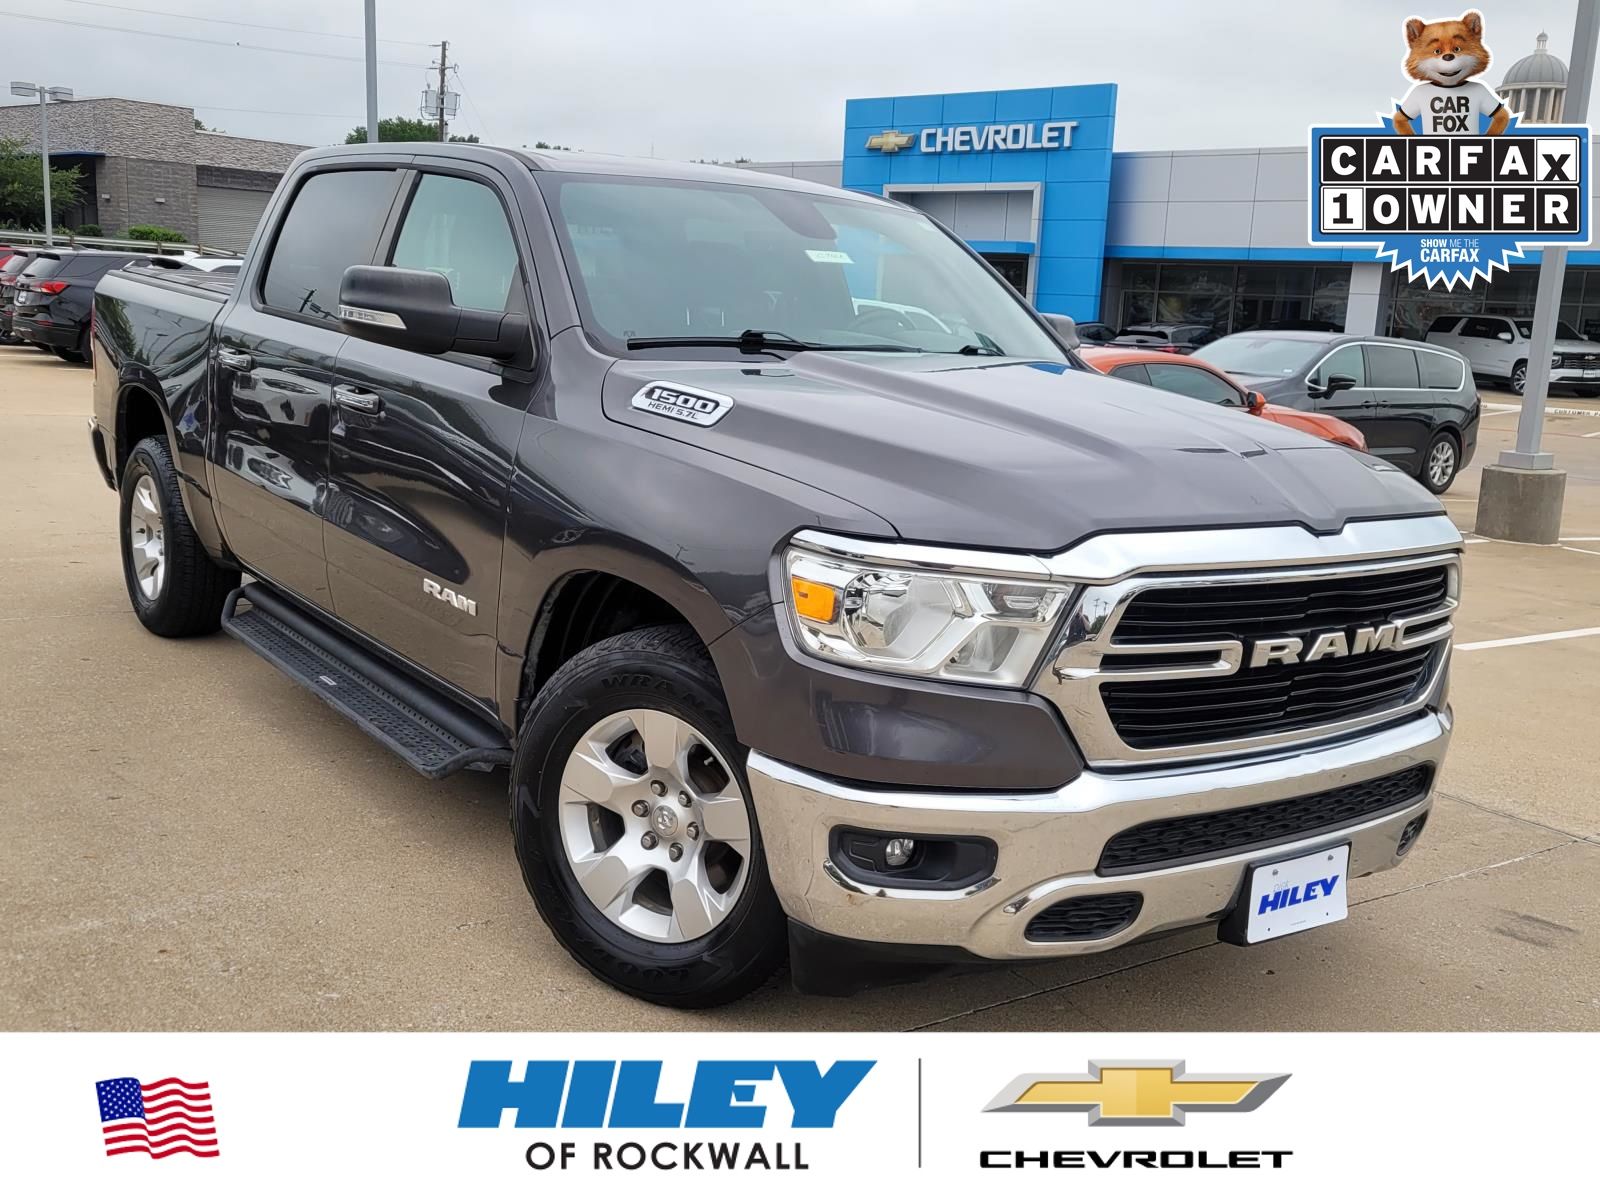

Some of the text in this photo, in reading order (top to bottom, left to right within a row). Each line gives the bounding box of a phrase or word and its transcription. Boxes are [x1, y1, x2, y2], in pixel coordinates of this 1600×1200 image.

[920, 121, 1079, 153] CHEVROLET
[648, 401, 698, 420] HEMI 5.7L
[651, 387, 717, 414] 1500
[423, 578, 478, 617] RAM
[1249, 623, 1398, 669] RAM
[1257, 874, 1340, 916] HILEY
